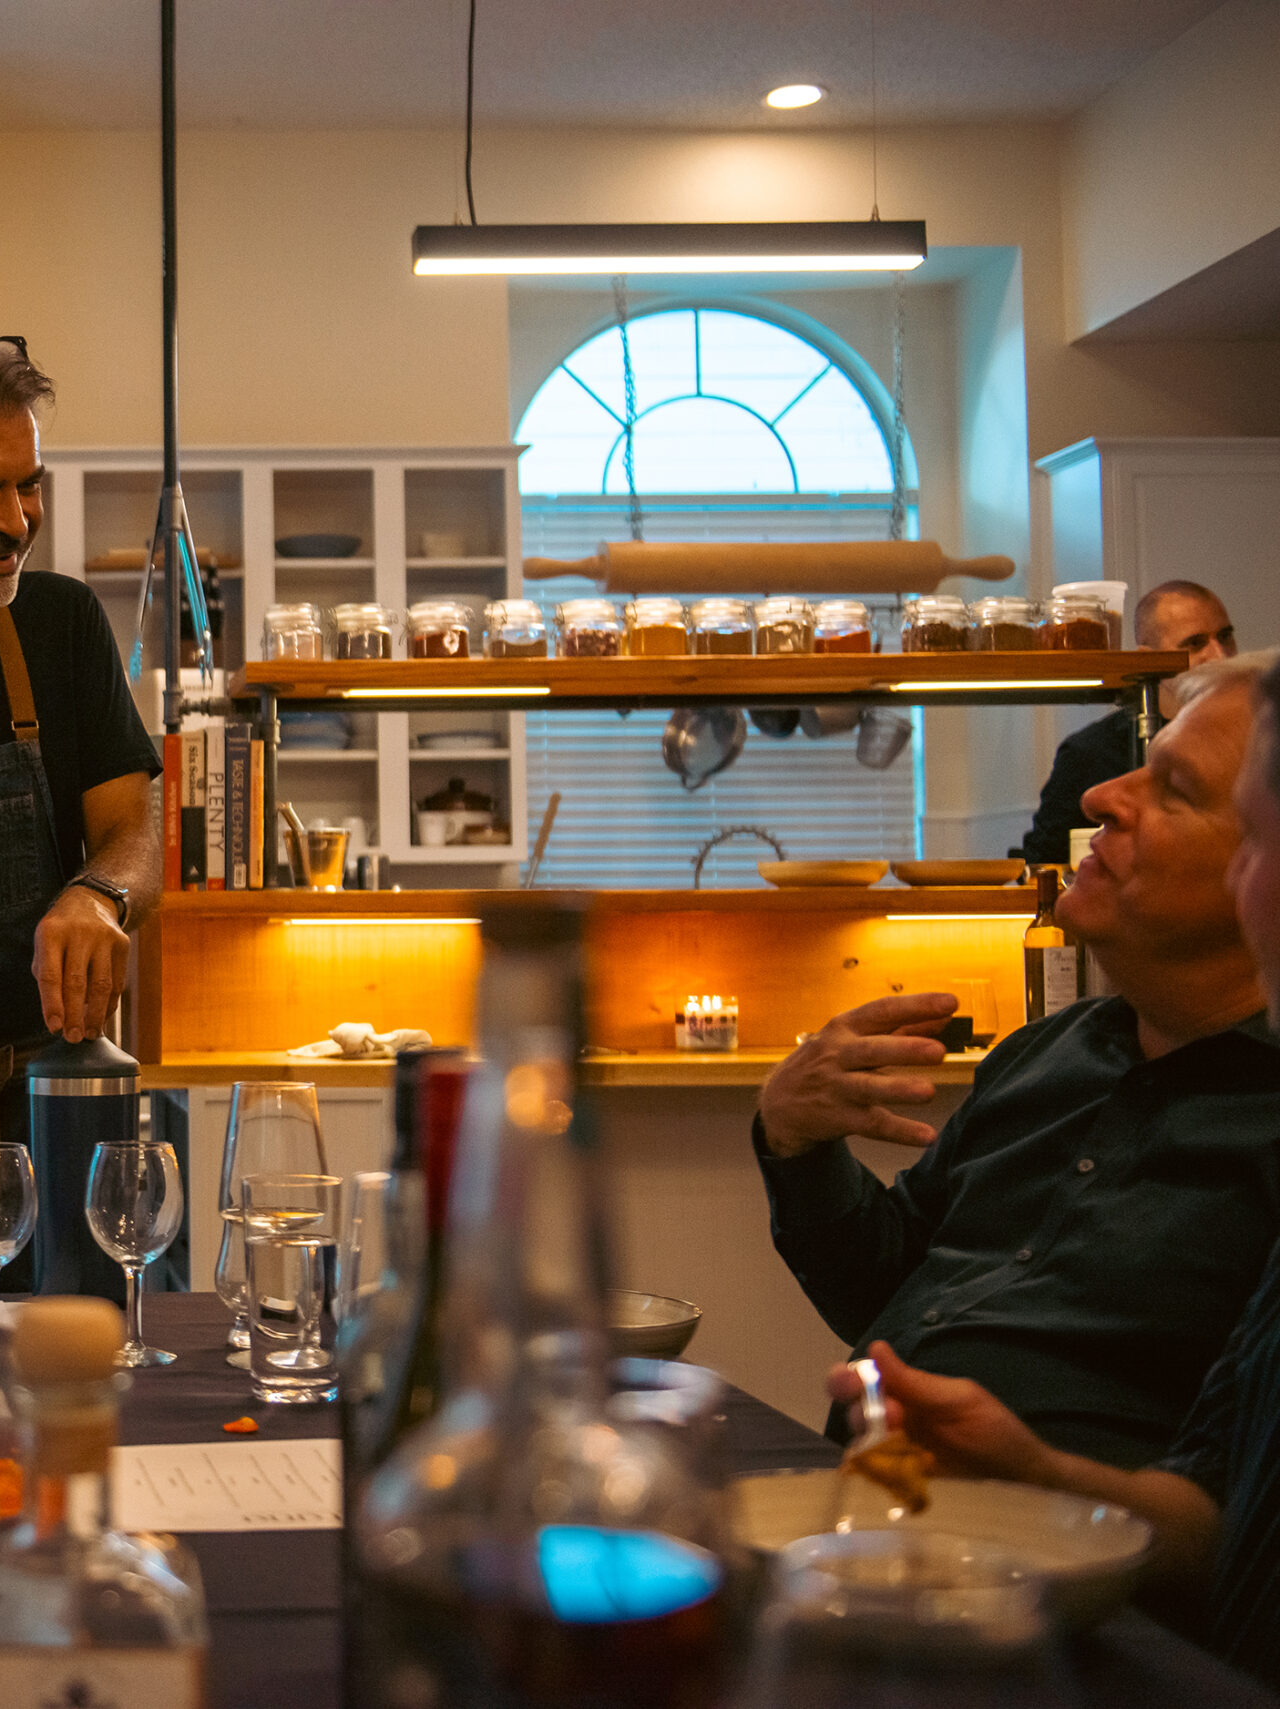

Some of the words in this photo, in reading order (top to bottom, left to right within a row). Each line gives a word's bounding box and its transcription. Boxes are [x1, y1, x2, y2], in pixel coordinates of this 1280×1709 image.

[188, 745, 199, 763] Six
[188, 765, 199, 806] Season
[232, 759, 245, 788] TASTE
[232, 789, 245, 799] &
[209, 772, 225, 852] PLENTY
